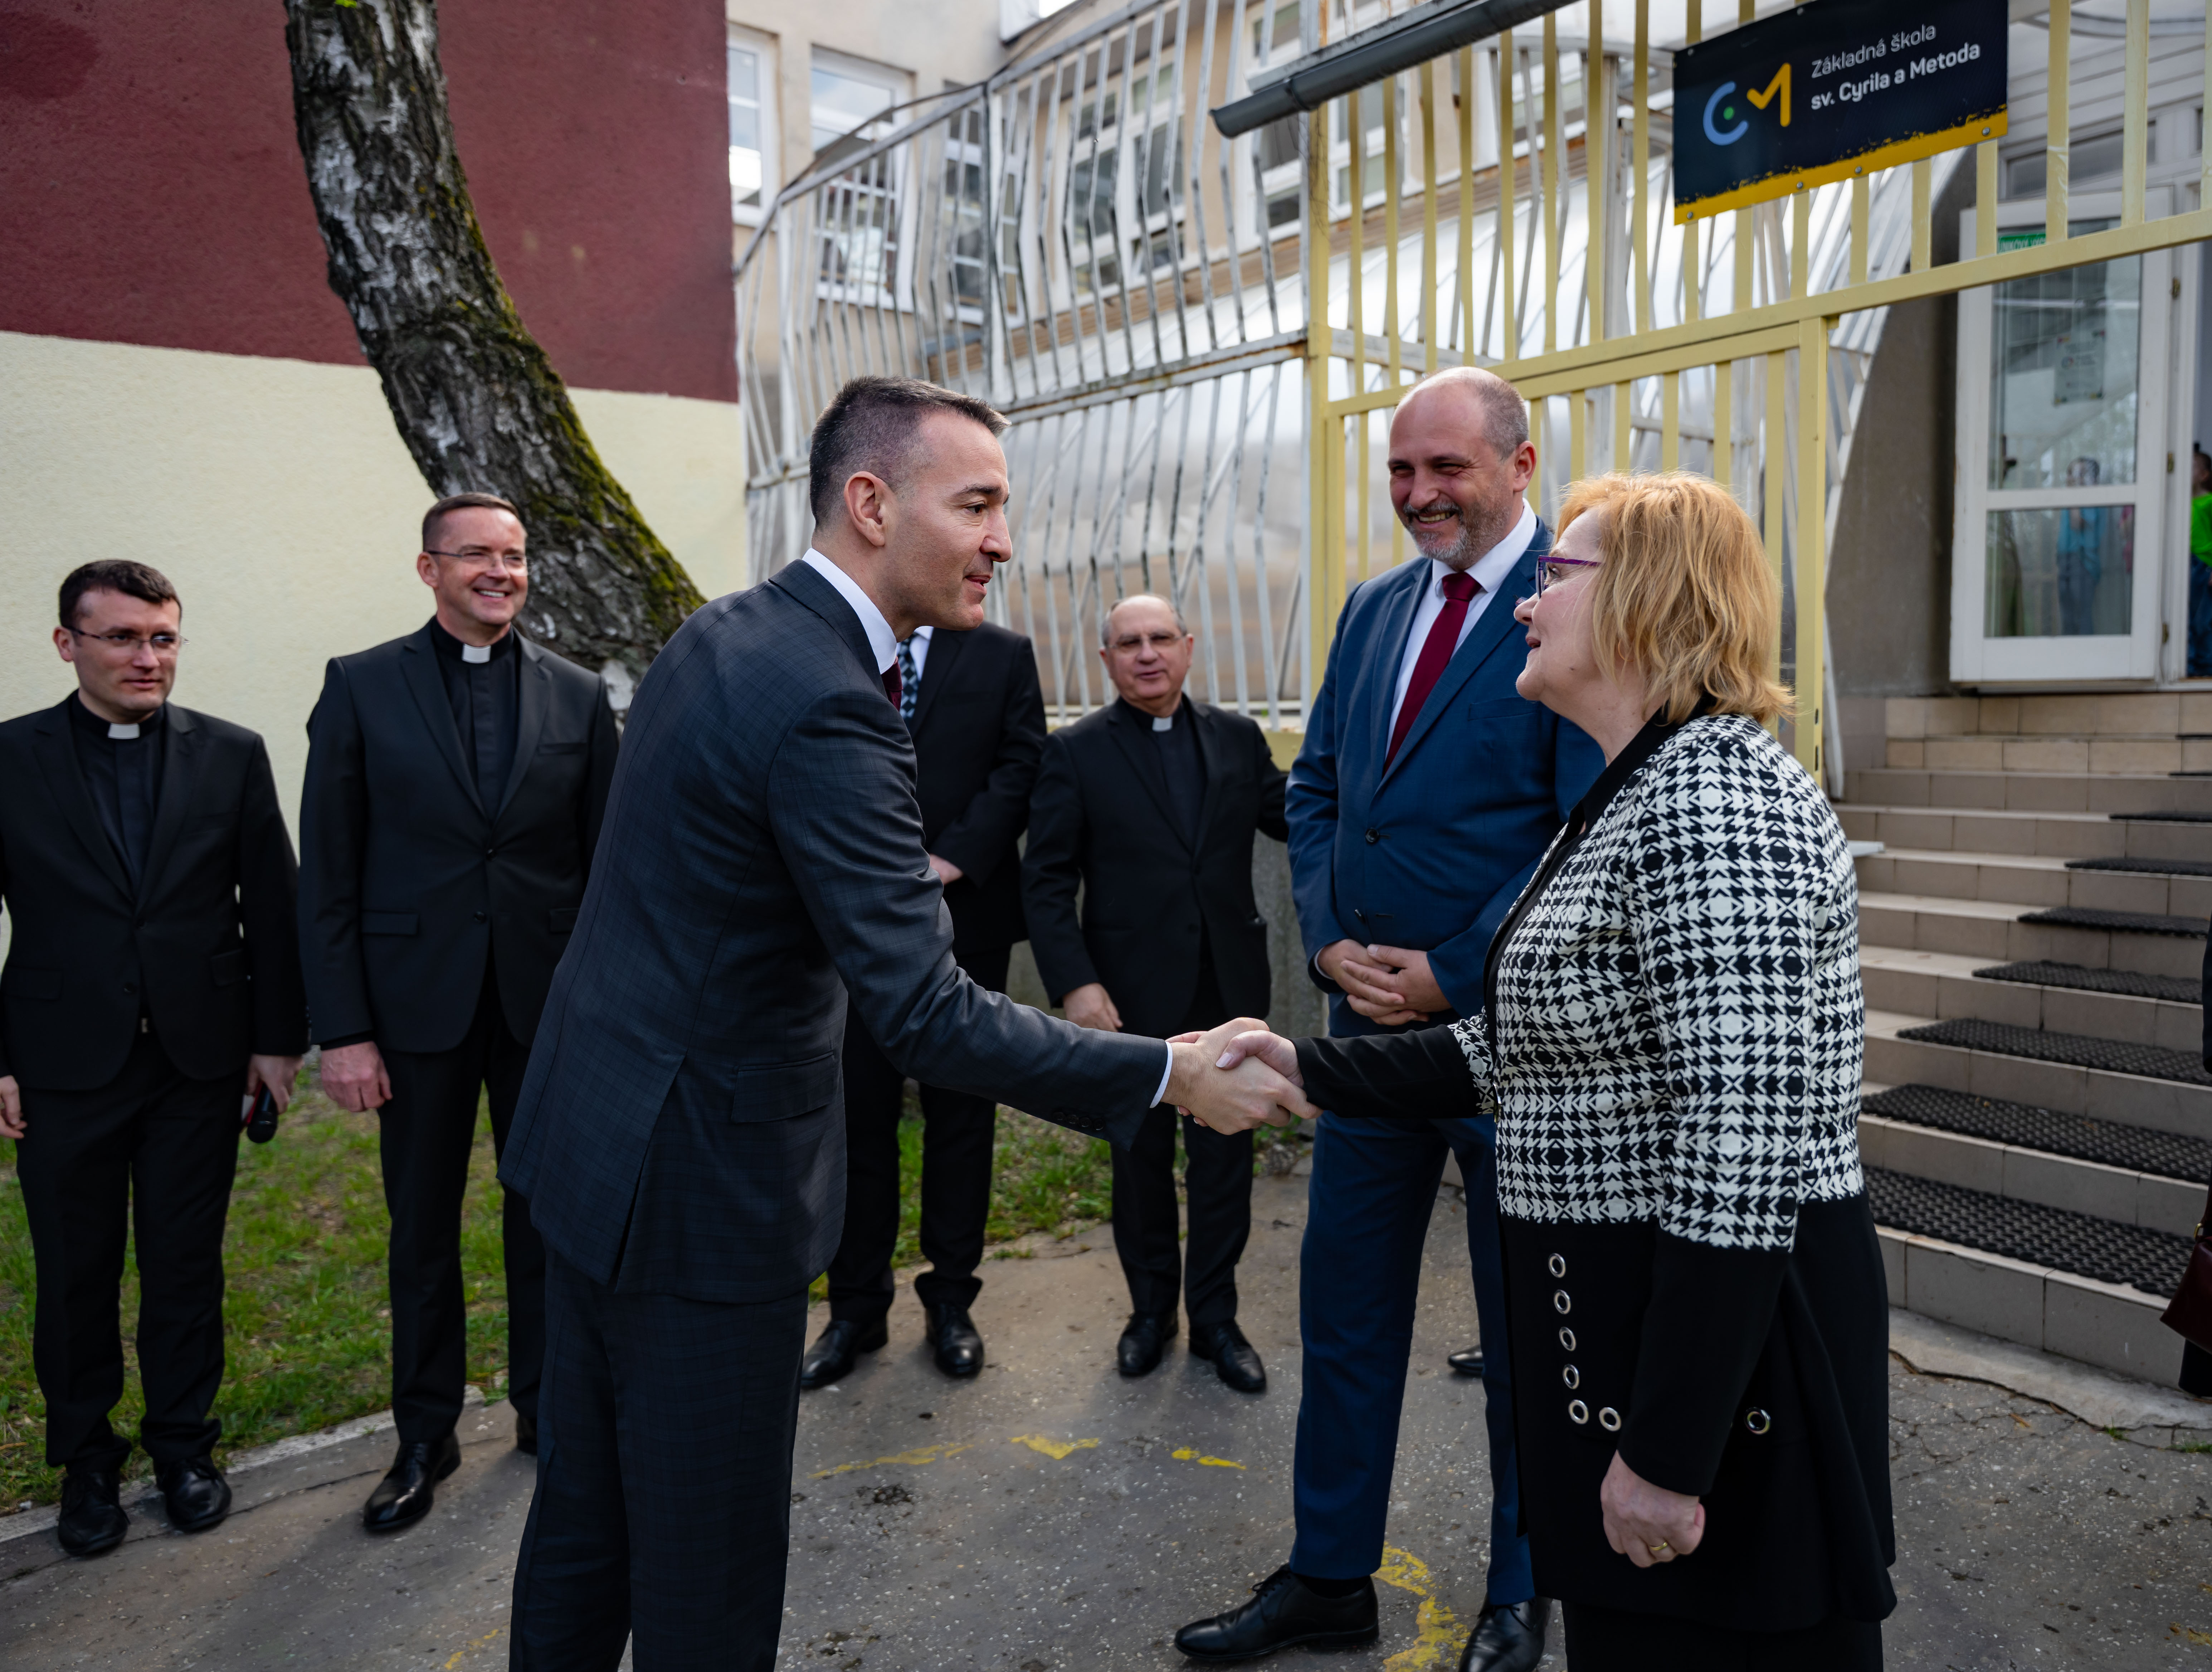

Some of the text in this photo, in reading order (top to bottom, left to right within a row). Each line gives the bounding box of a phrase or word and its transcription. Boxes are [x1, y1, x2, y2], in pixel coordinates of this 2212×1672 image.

[1811, 24, 1936, 78] Základná škola
[1811, 42, 1980, 110] sv. Cyrila a Metoda
